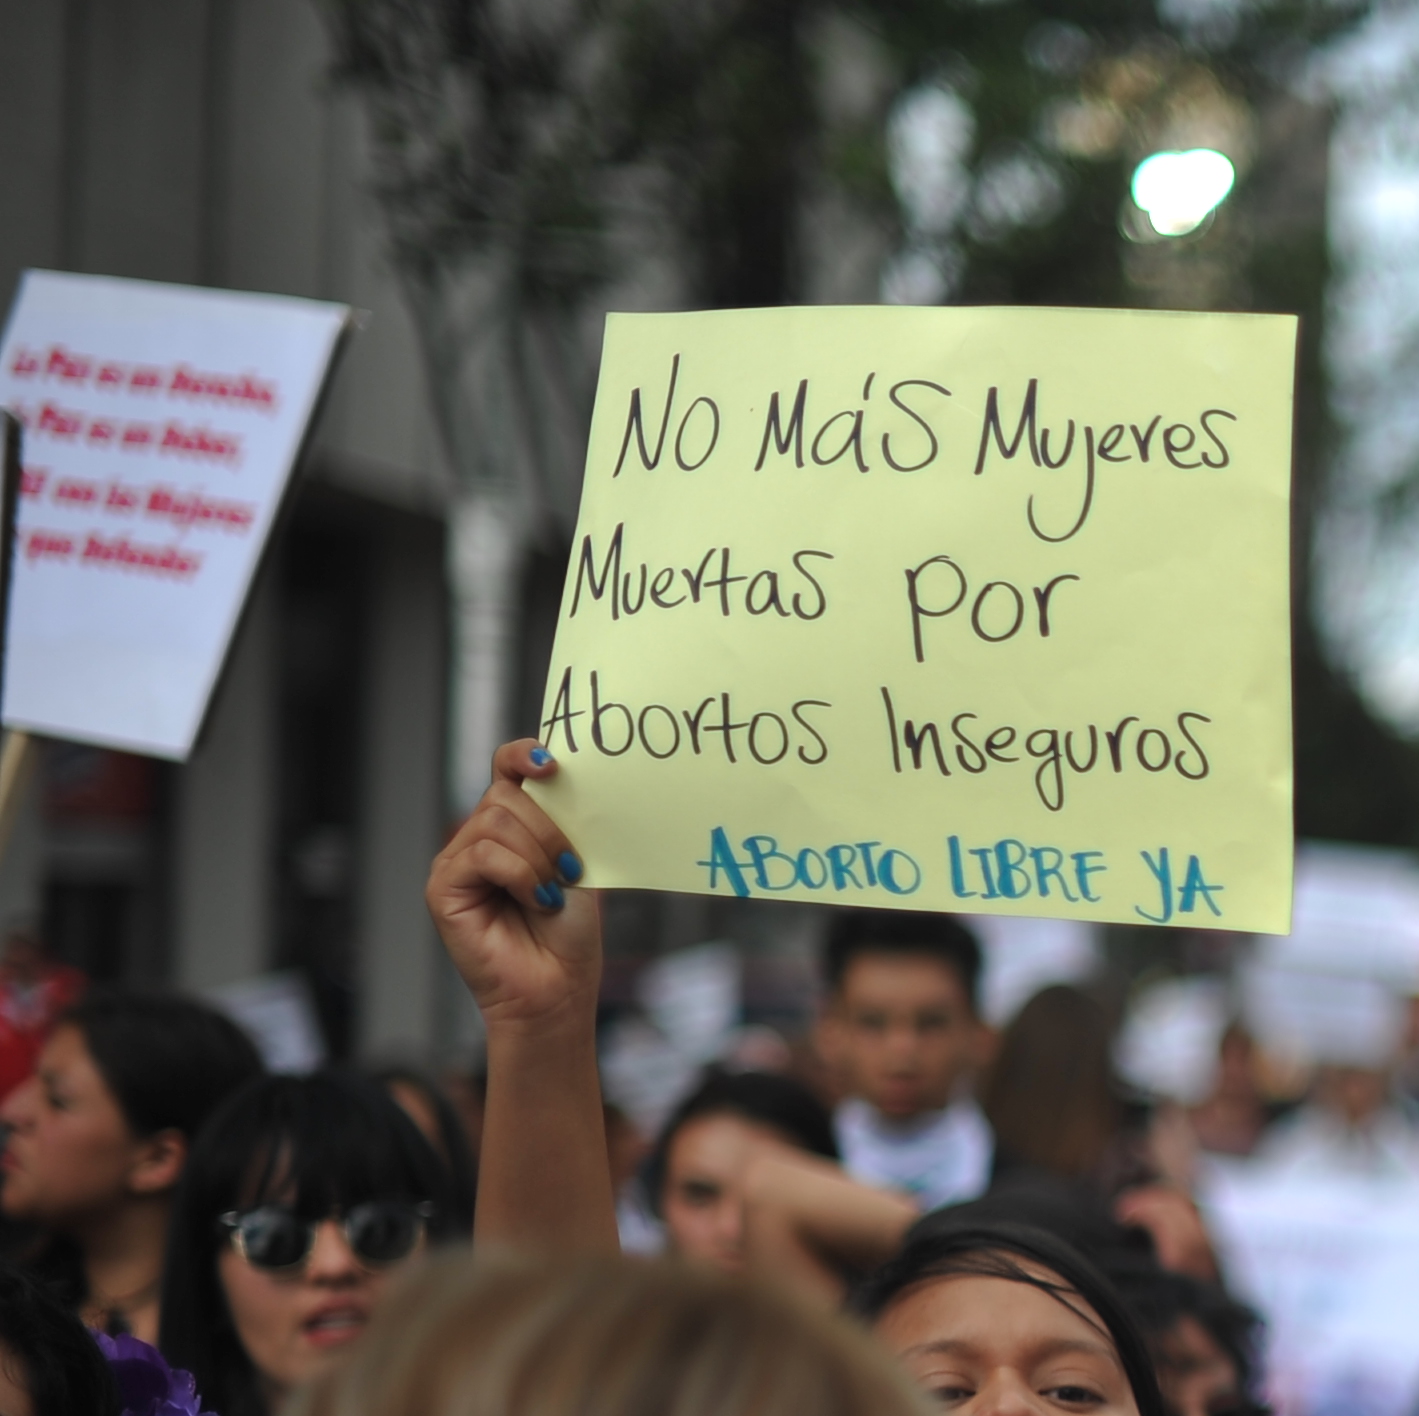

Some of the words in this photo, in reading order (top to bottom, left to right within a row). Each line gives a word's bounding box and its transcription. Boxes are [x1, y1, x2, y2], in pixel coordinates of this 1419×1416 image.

[613, 354, 719, 478] NO
[974, 378, 1236, 542] Mujeres
[569, 522, 834, 620] Muertas
[543, 666, 832, 765] Abortos
[881, 687, 1211, 811] Inseguros
[697, 826, 920, 899] ABORTO
[947, 835, 1106, 902] LIBRE
[1136, 848, 1223, 923] YA
